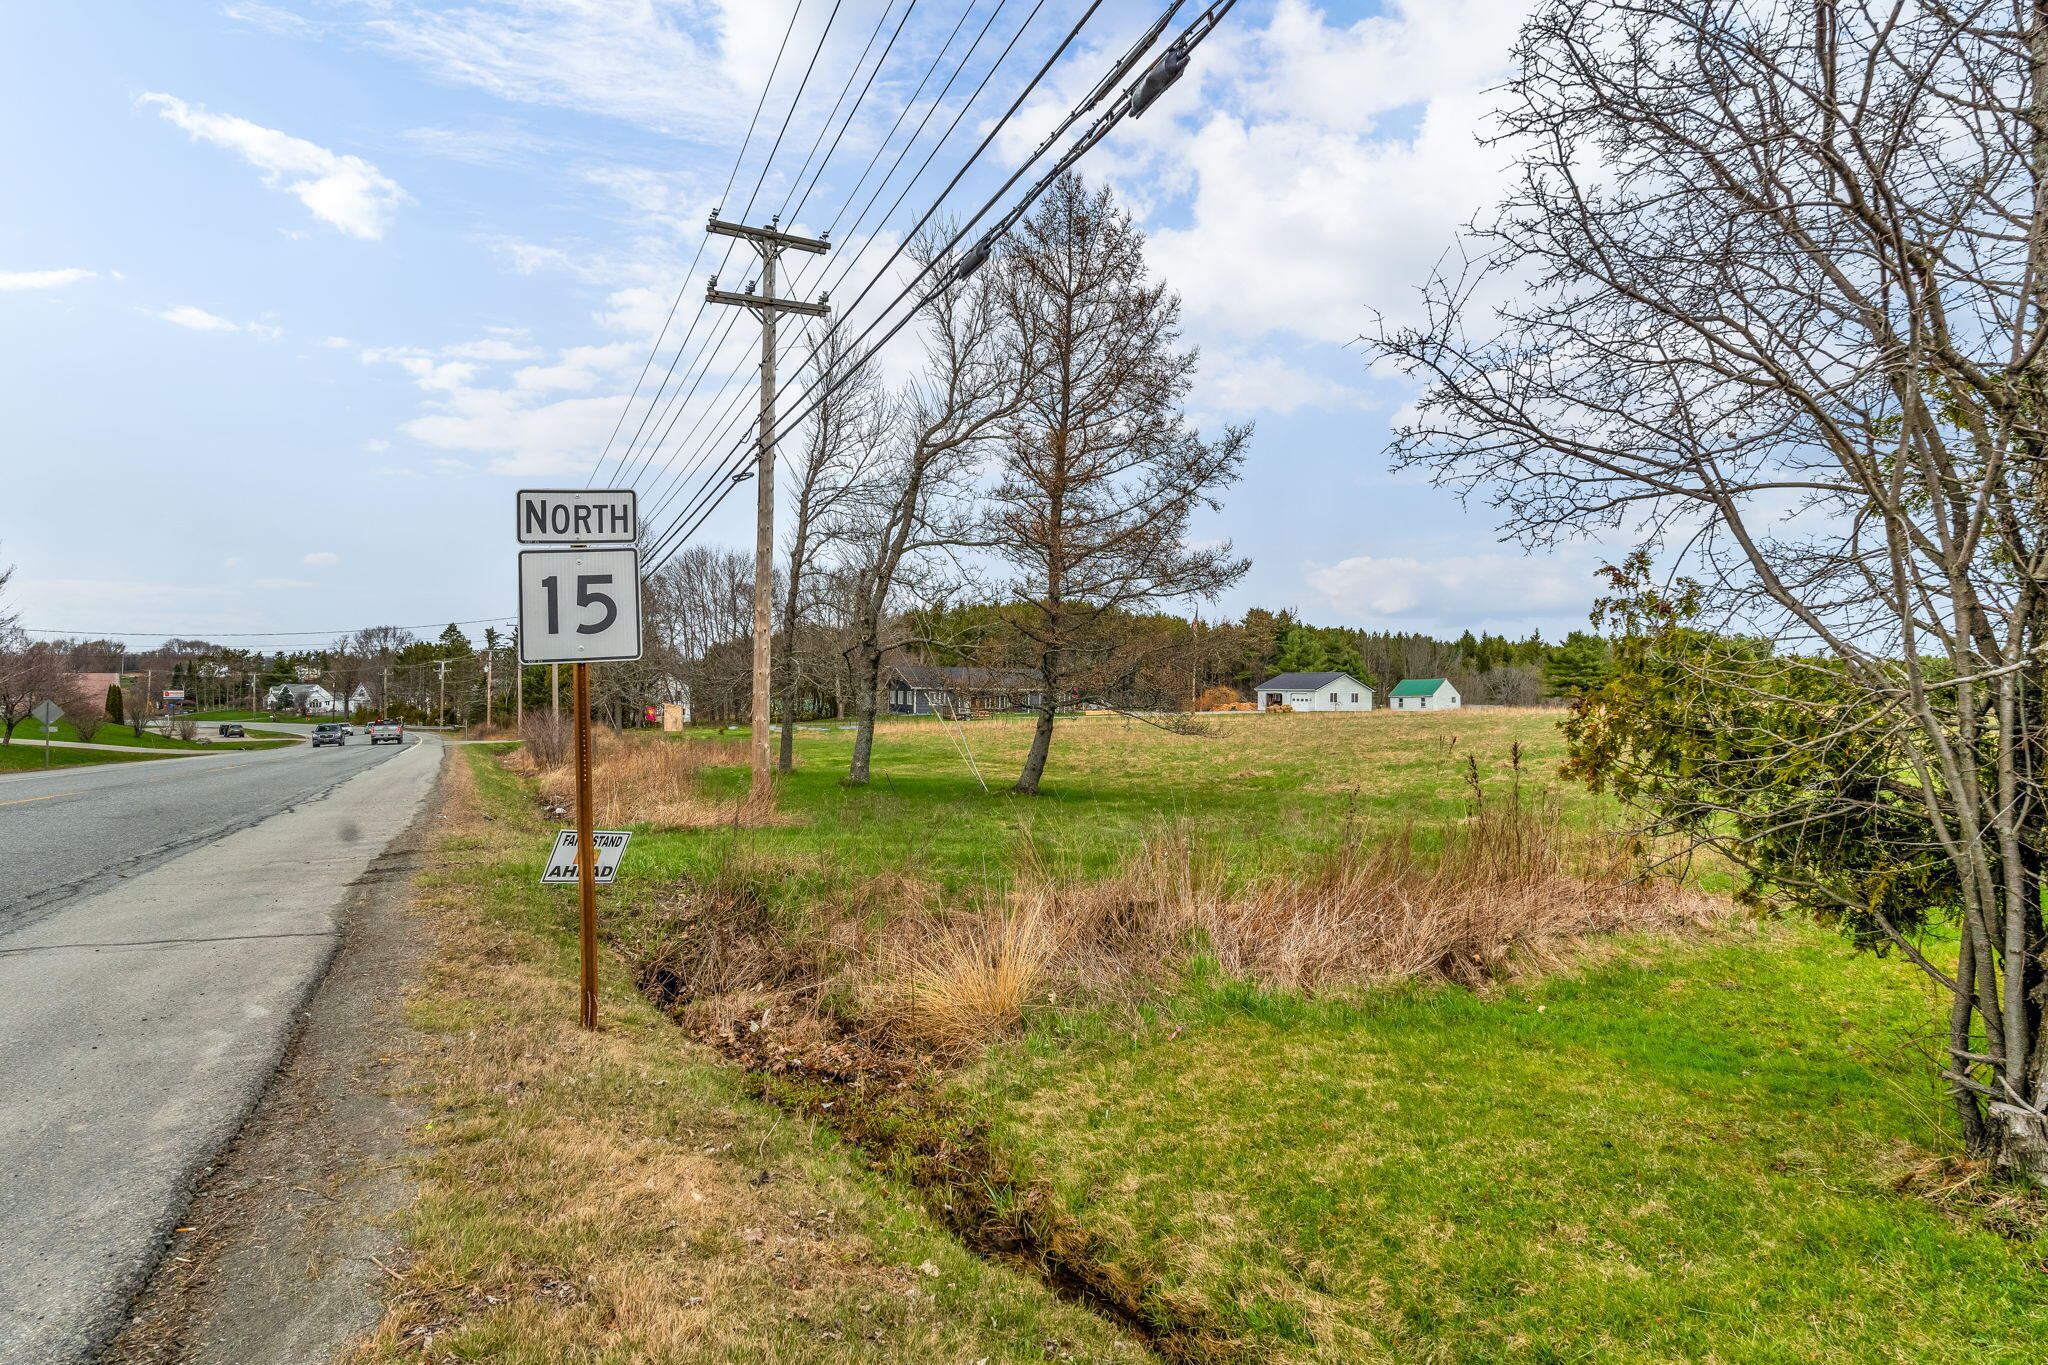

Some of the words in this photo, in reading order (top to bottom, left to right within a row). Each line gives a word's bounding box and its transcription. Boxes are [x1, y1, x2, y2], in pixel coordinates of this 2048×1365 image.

[526, 500, 628, 534] NORTH
[541, 574, 617, 634] 15
[562, 835, 580, 847] FA
[548, 866, 613, 877] AHD
